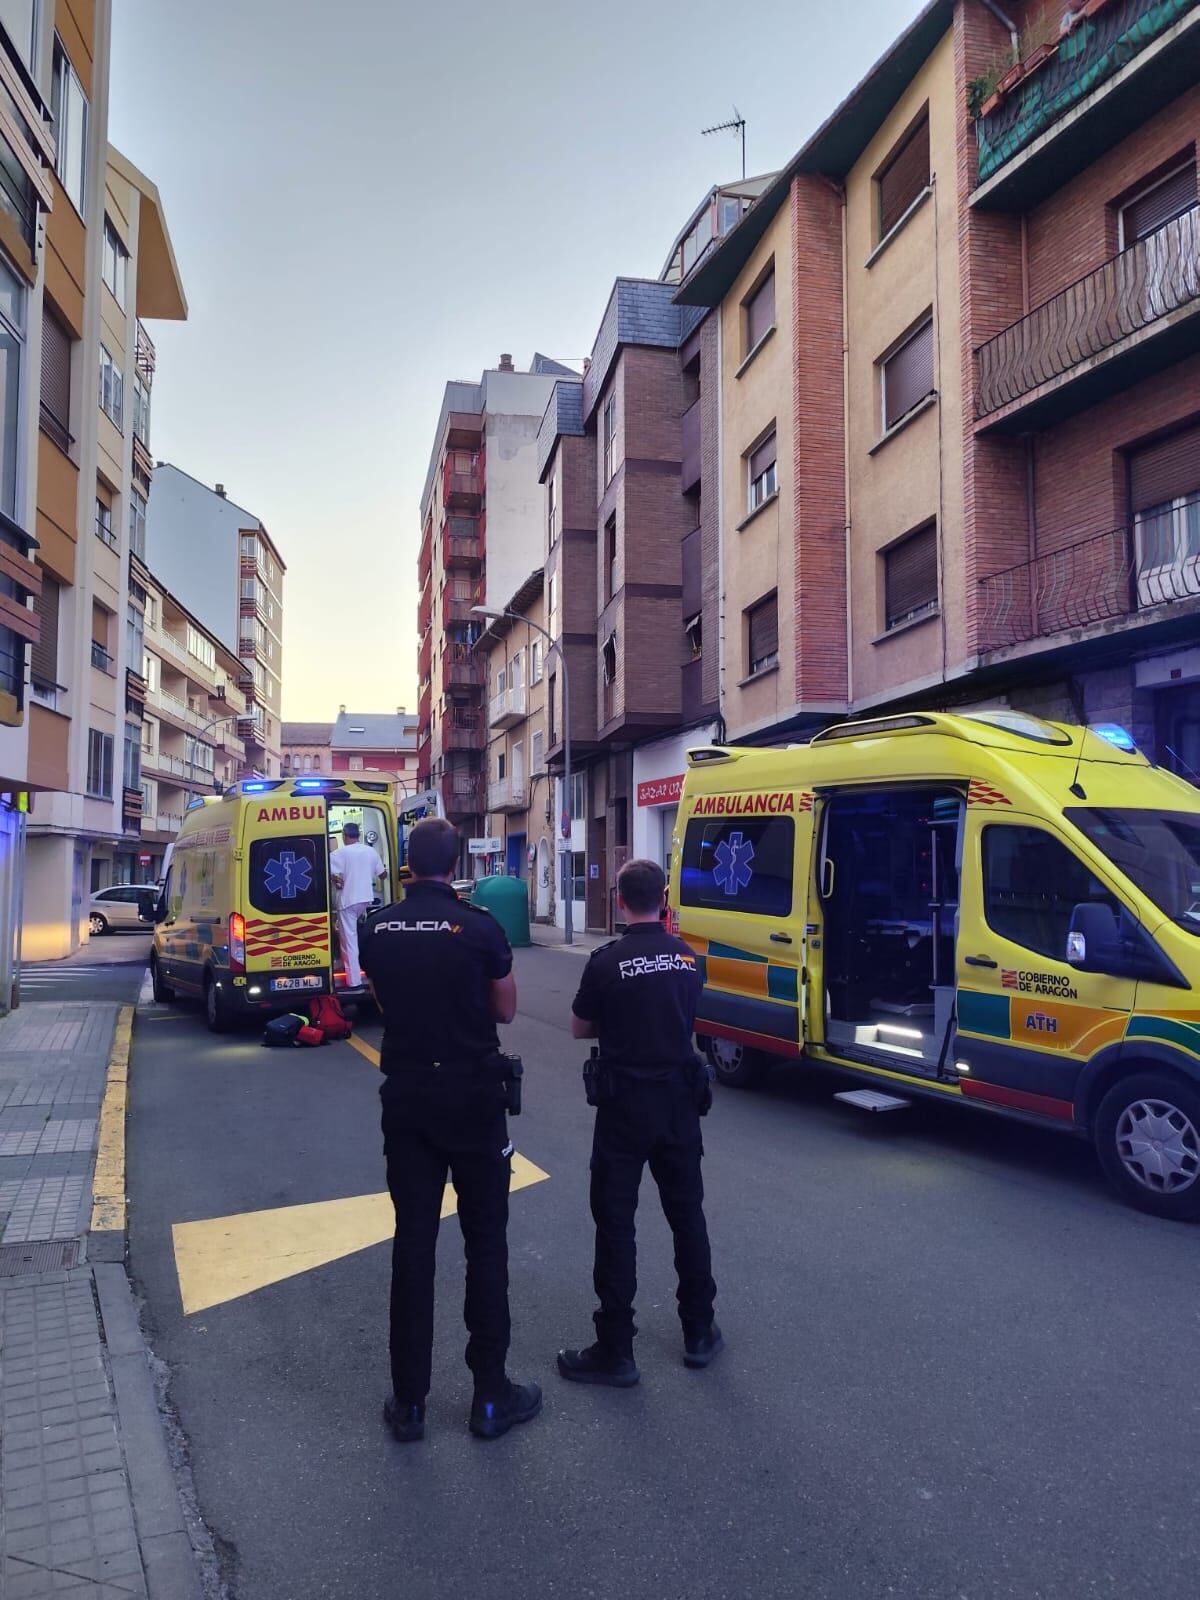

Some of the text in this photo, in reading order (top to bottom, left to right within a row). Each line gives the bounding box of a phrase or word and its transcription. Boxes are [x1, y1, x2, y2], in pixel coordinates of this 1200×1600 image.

[693, 792, 794, 815] AMBULANCIA
[257, 805, 325, 822] AMBUL
[374, 921, 452, 934] POLICIA
[282, 953, 316, 962] GOBIERNO
[293, 958, 321, 967] ARAGON
[619, 953, 683, 971] POLICIA
[621, 961, 697, 979] NACIONAL
[276, 978, 320, 989] 6428 MLJ
[1018, 971, 1070, 987] GOBIERNO
[1019, 981, 1078, 999] DE ARAGON
[1026, 1013, 1057, 1033] ATH
